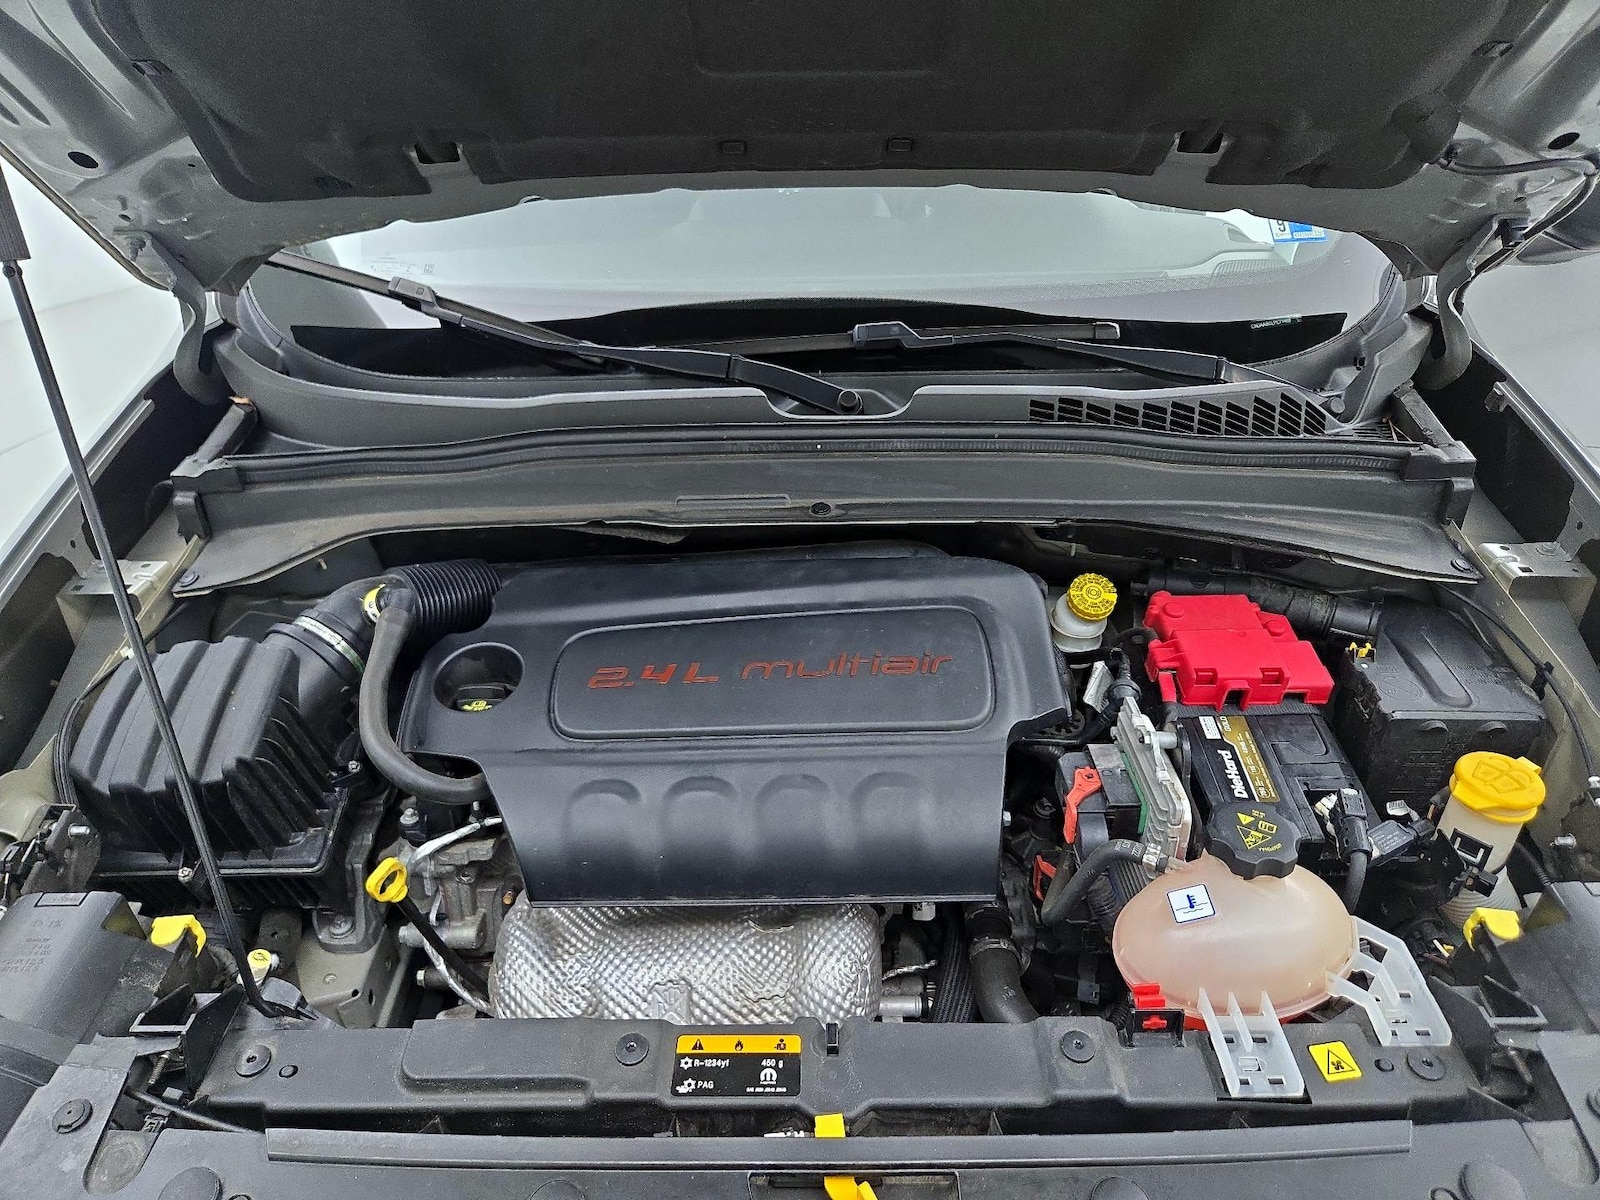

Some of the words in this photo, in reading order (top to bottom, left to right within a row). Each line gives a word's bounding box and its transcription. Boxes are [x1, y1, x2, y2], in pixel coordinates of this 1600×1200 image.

[741, 651, 953, 679] multiair
[1220, 716, 1232, 732] GOLD
[1217, 749, 1249, 799] DieHard
[694, 1058, 729, 1068] R-1234yf
[778, 1059, 784, 1069] g
[697, 1080, 714, 1089] PAG
